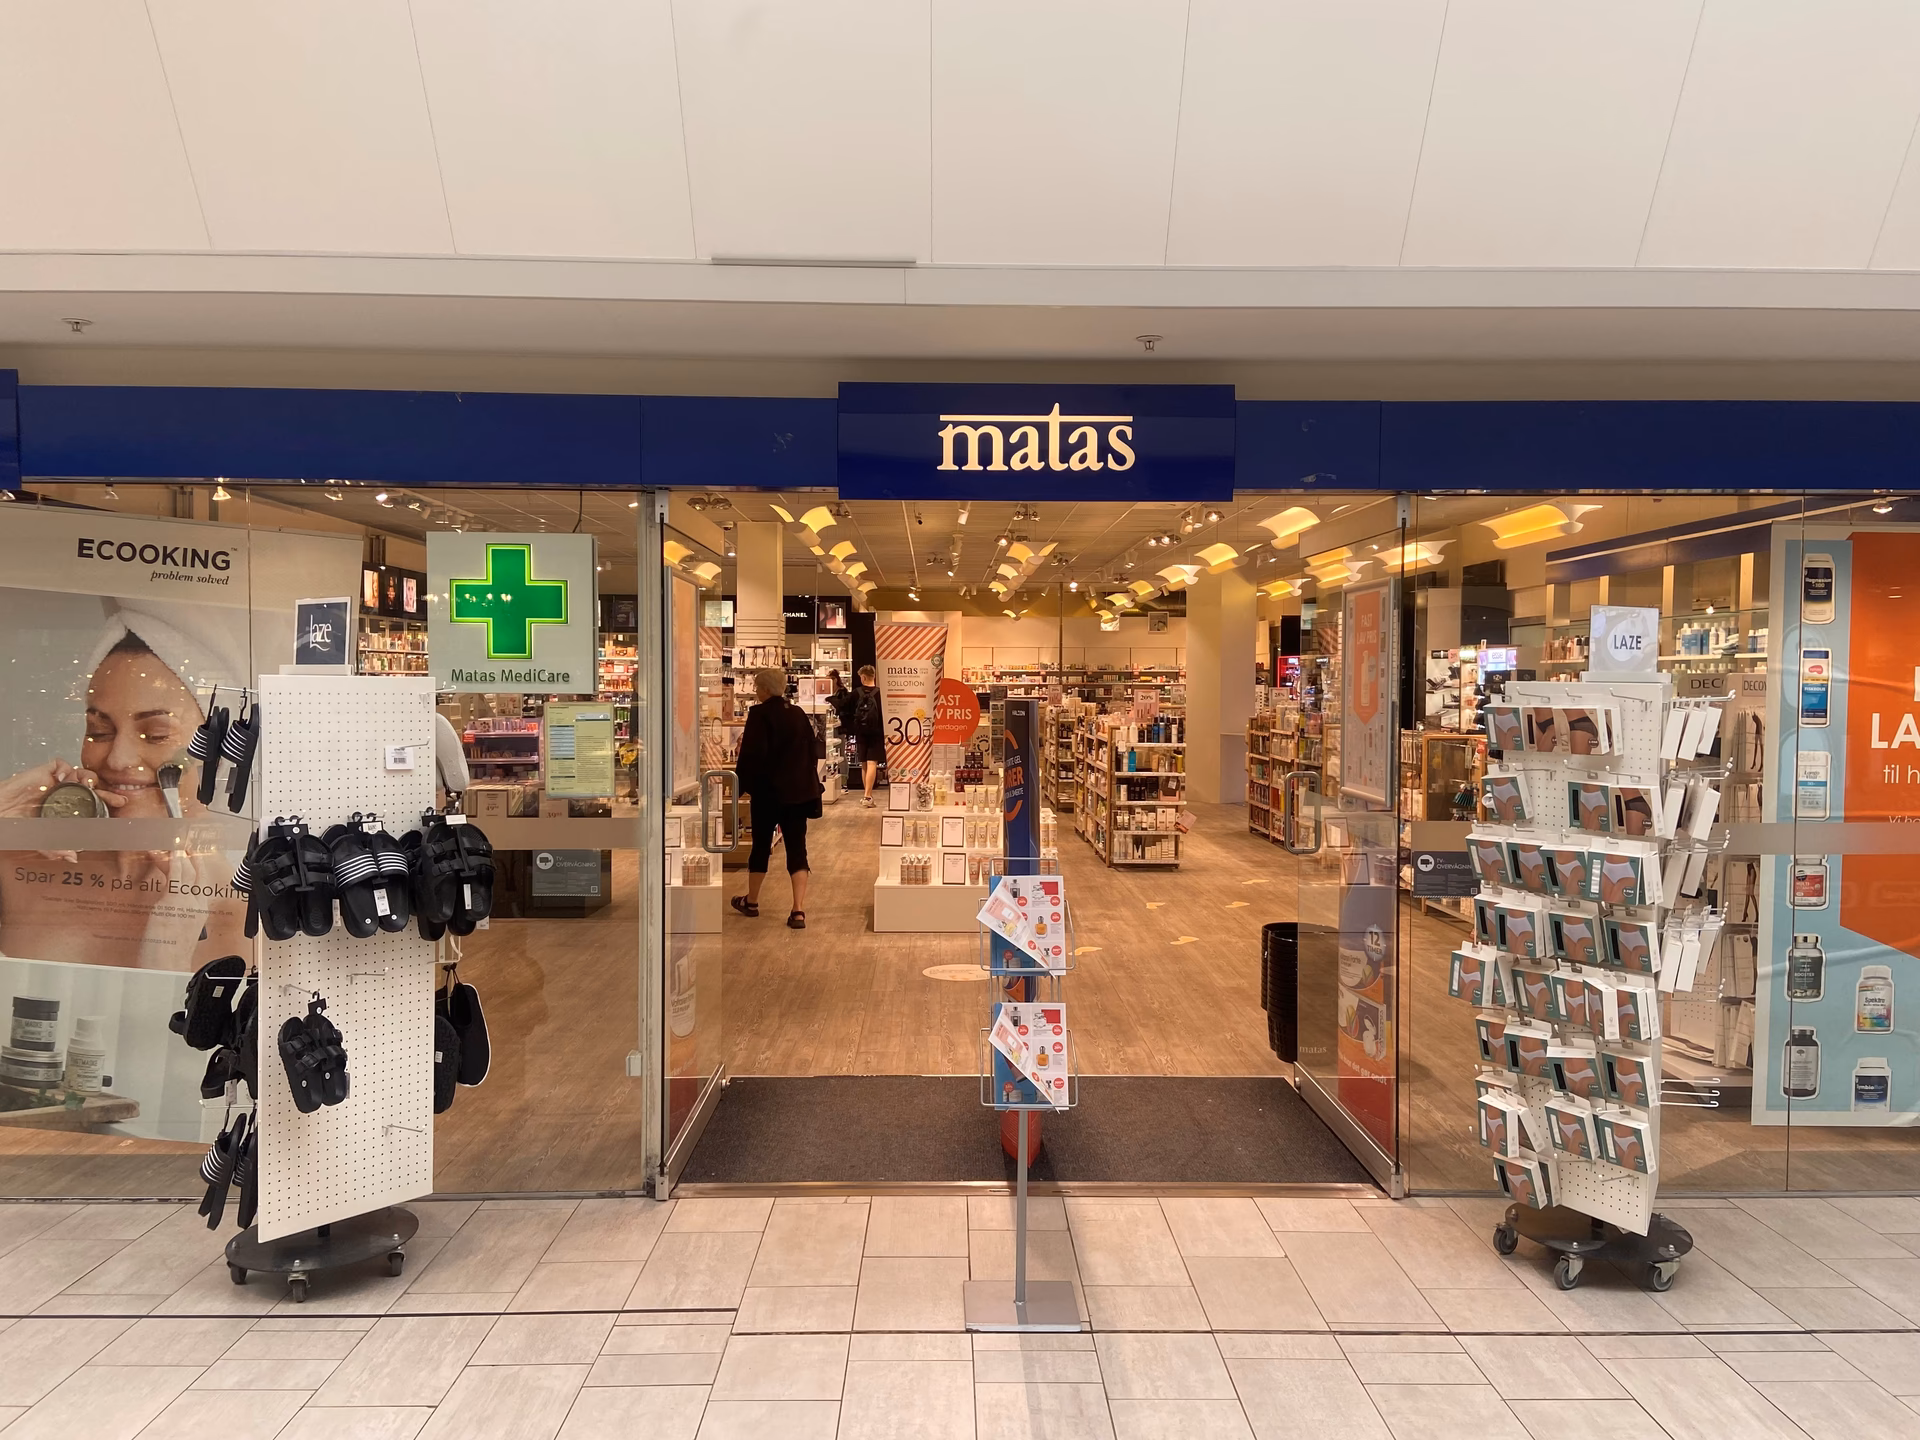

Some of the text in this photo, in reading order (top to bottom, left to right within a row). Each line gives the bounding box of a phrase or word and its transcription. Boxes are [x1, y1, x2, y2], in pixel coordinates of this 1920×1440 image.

[937, 402, 1136, 471] matas
[77, 538, 231, 571] ECOOKING
[150, 570, 230, 585] problem solved
[1613, 634, 1642, 650] LAZE
[450, 668, 570, 683] Matas MediCare
[887, 666, 918, 675] matas
[1690, 678, 1724, 689] DEC
[937, 694, 961, 706] AST
[946, 708, 972, 720] PRIS
[887, 716, 922, 746] 30
[1870, 713, 1920, 749] LA
[1882, 764, 1900, 784] til
[15, 867, 56, 884] Spar
[61, 871, 83, 886] 25
[90, 874, 105, 888] %
[111, 874, 133, 891] på
[139, 877, 162, 893] alt
[1368, 931, 1381, 947] 12
[1366, 944, 1383, 955] TIMER
[1299, 1046, 1328, 1054] matas
